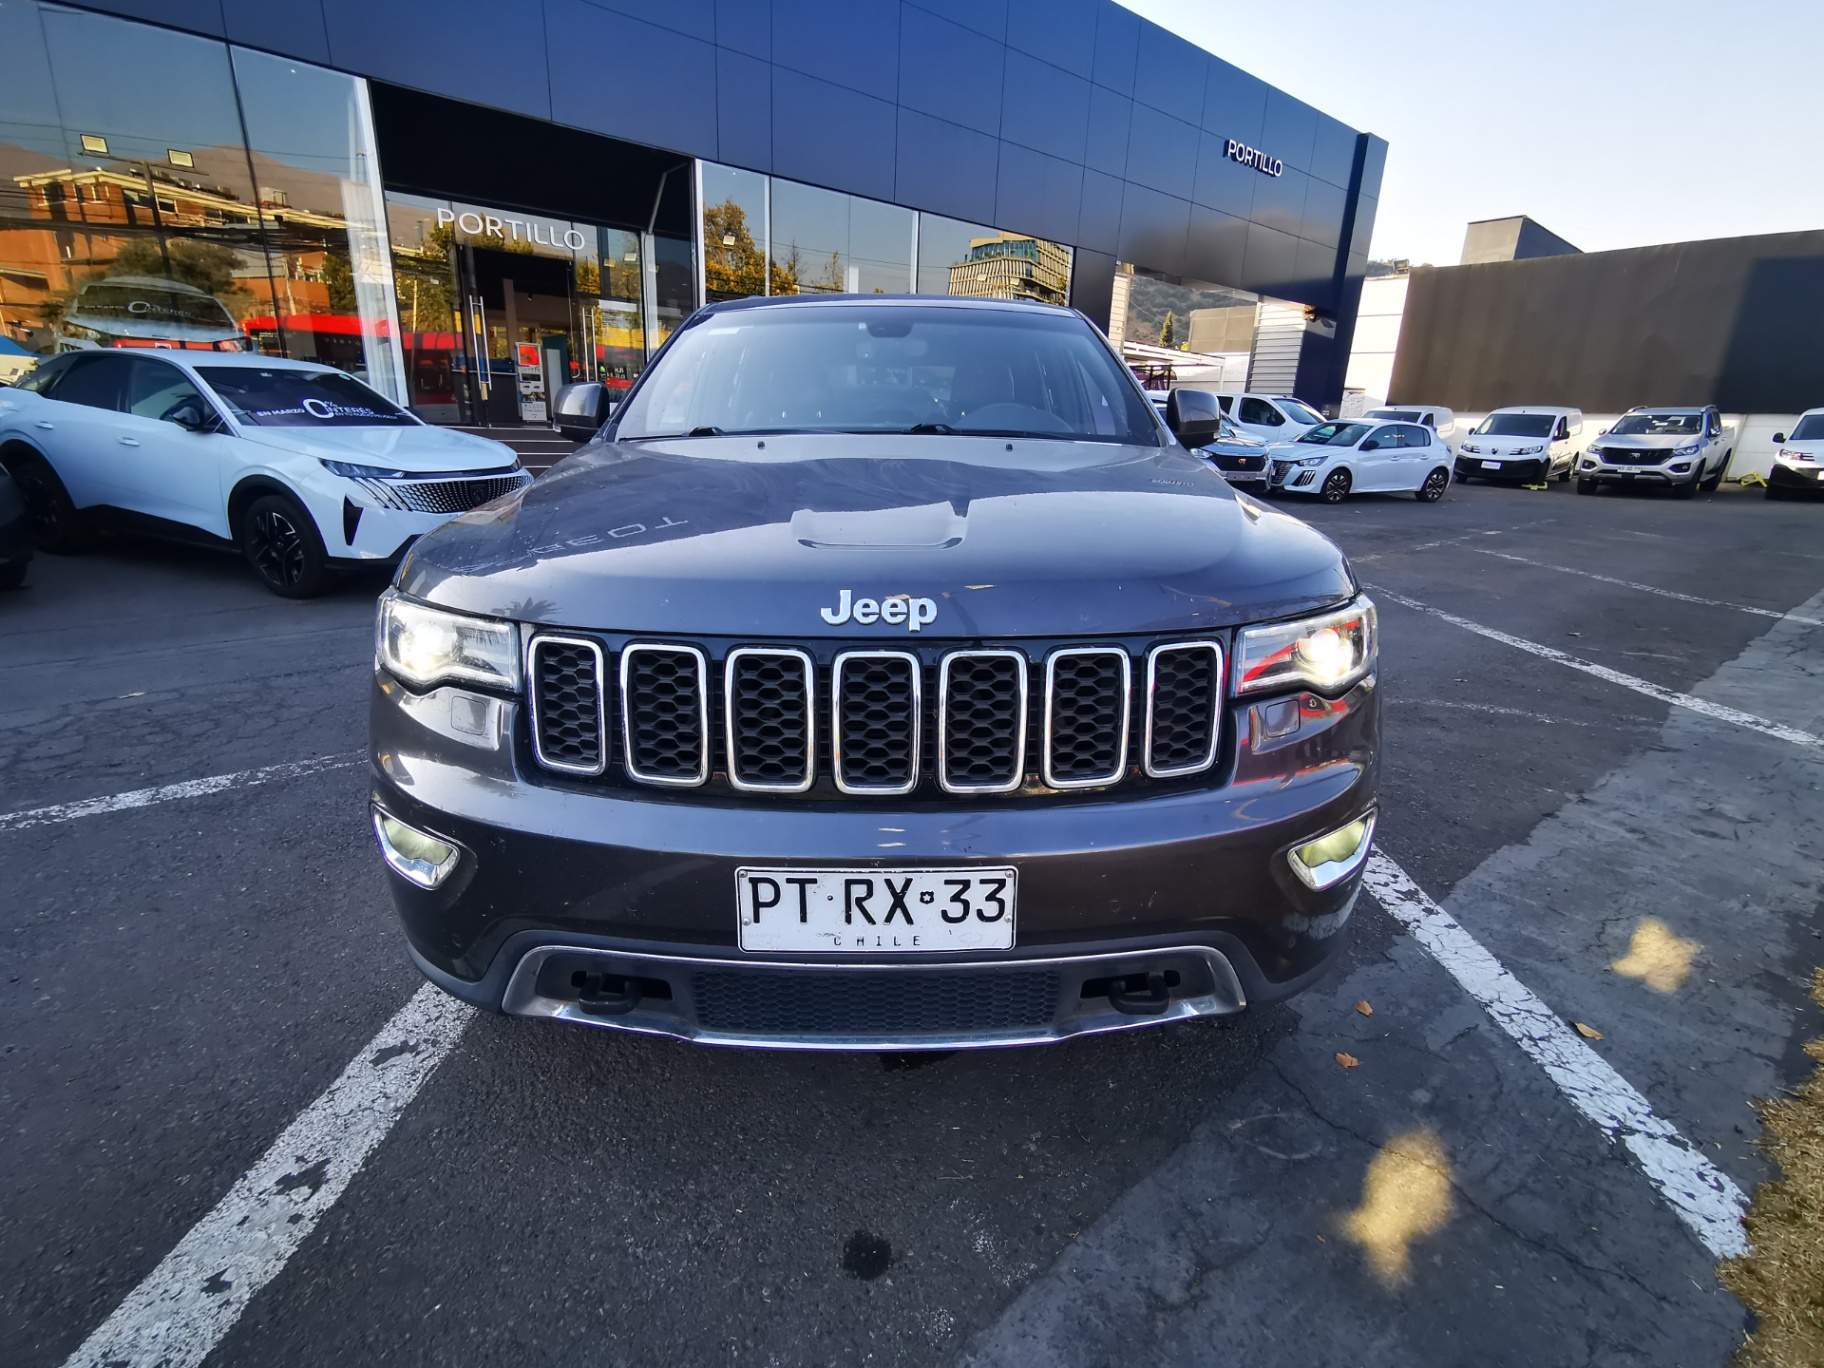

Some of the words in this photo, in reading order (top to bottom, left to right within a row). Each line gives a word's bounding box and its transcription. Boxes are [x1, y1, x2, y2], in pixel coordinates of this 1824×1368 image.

[1227, 138, 1283, 177] PORTILLO
[437, 207, 585, 250] PORTILLO
[820, 589, 938, 632] Jeep
[833, 935, 921, 947] CHILE
